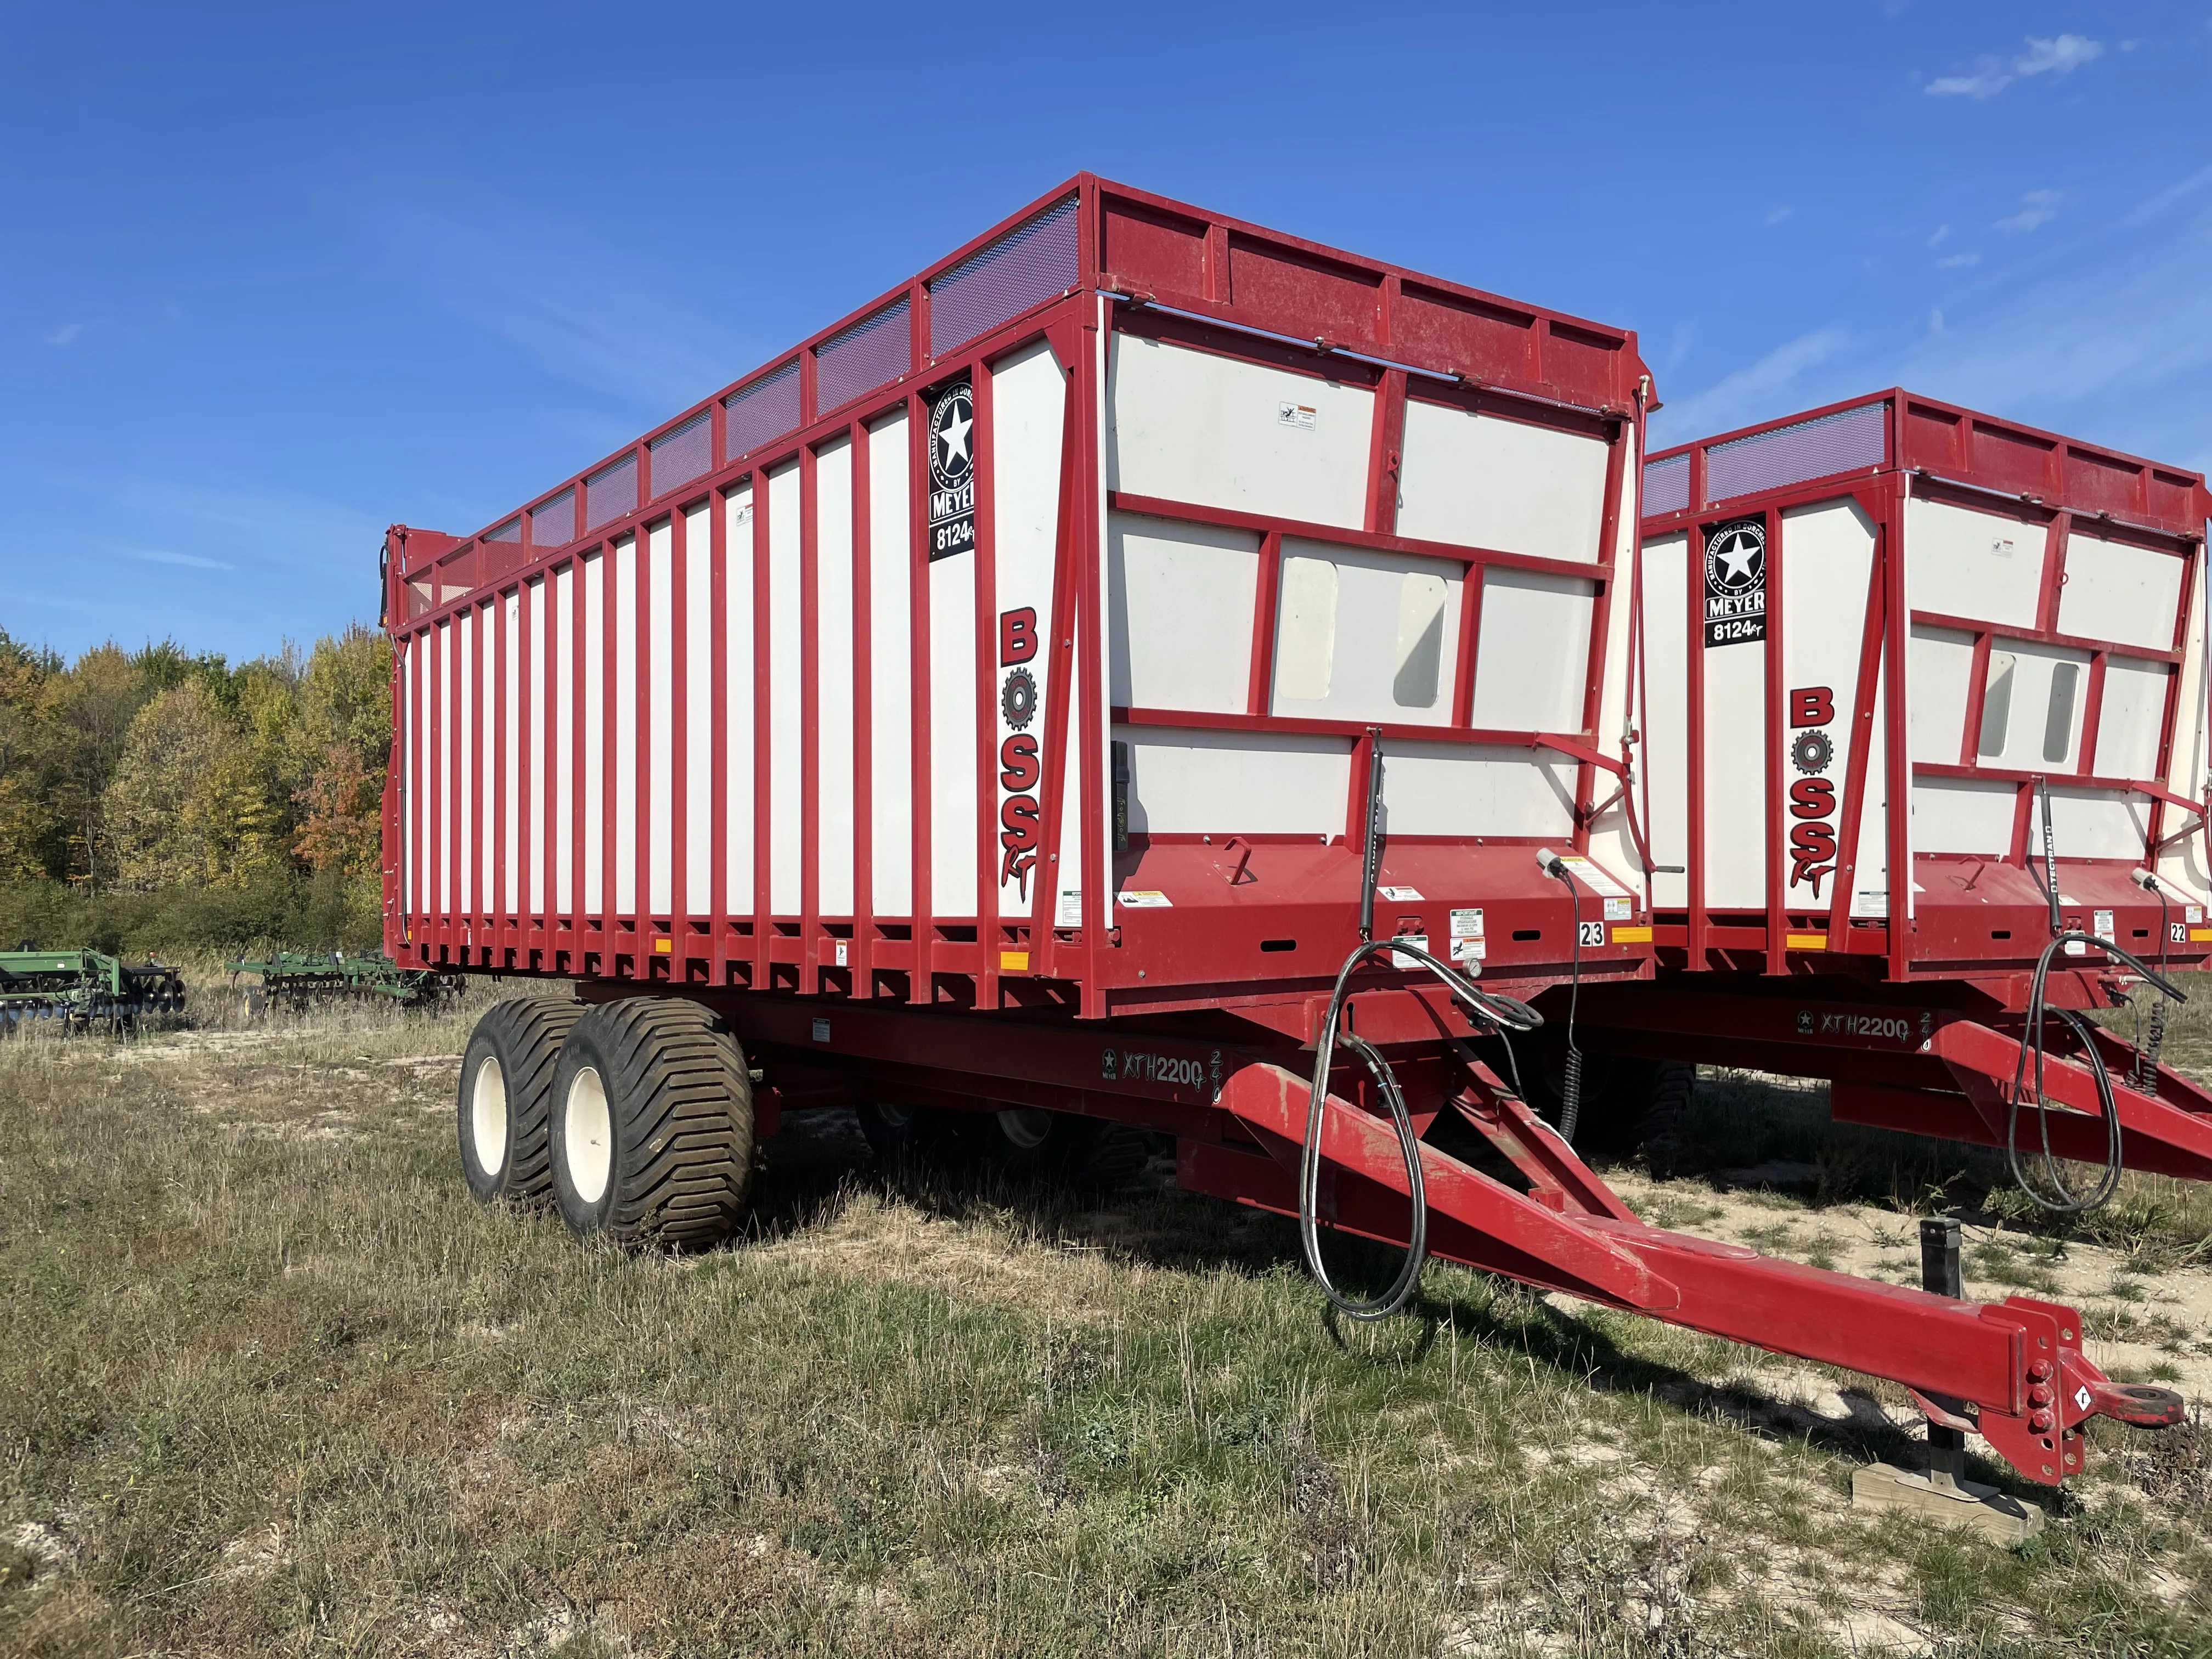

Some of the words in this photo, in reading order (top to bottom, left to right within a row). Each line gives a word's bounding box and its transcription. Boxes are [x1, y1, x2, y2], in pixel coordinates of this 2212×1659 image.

[932, 393, 951, 467] MANUFACTURED
[953, 478, 960, 487] BY
[1708, 527, 1732, 580] MANUFACTURED
[1710, 591, 1764, 617] MEYER
[1581, 923, 1603, 945] 23
[2172, 924, 2185, 941] 22
[1102, 1071, 1116, 1080] MEYER
